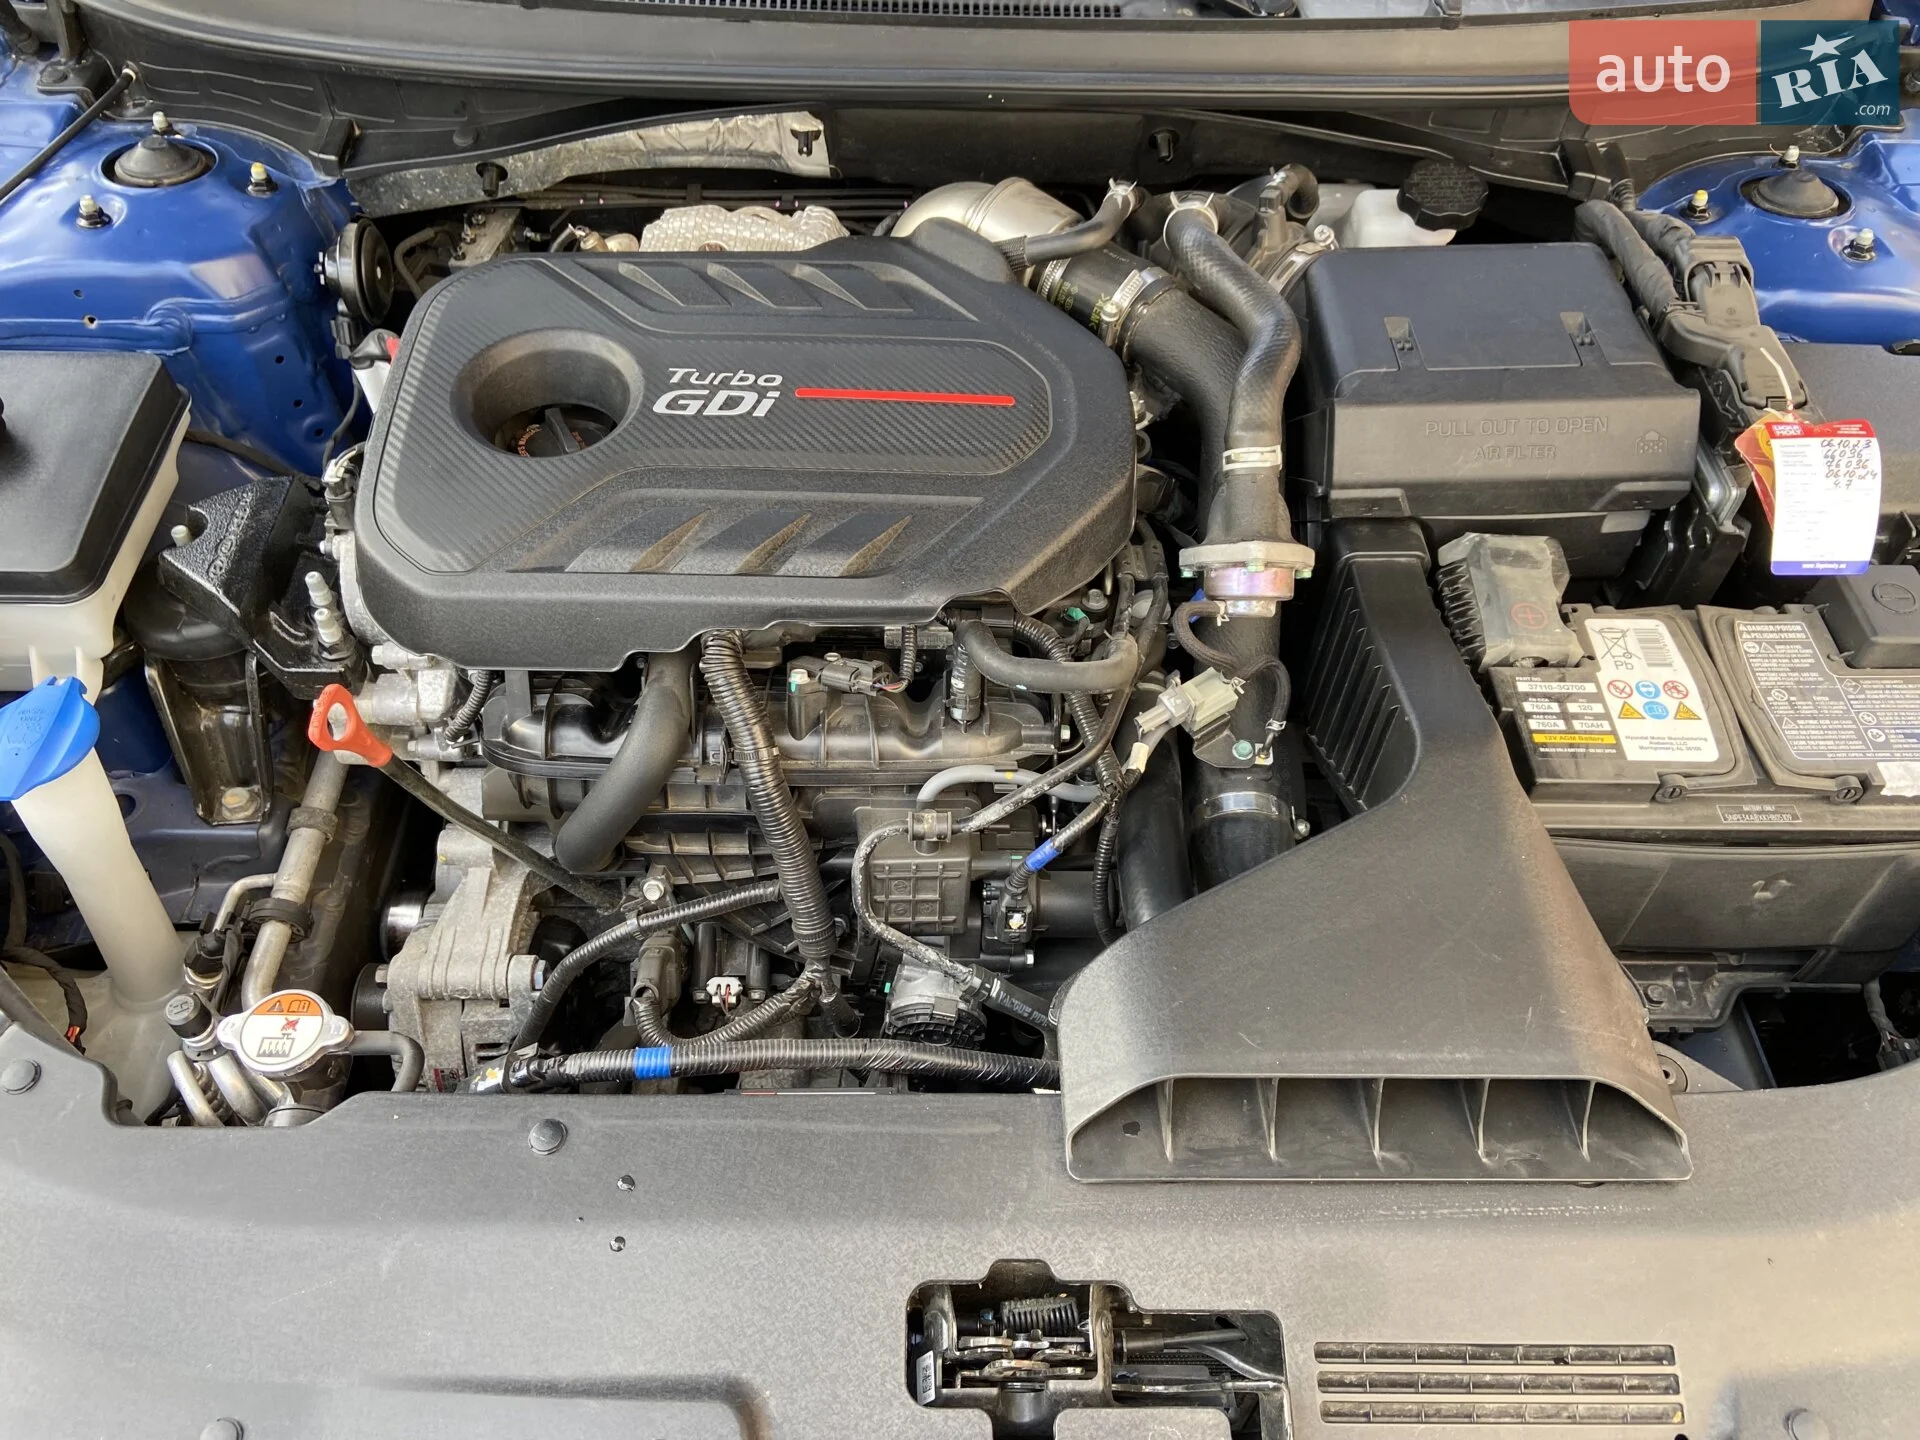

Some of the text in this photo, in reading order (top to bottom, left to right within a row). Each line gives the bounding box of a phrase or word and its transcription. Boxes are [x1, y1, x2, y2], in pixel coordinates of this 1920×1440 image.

[668, 368, 783, 386] Turbo
[652, 389, 781, 417] GDi
[1425, 416, 1609, 436] PULL OUT TO OPEN
[1474, 445, 1557, 460] AIR FILTER
[1614, 660, 1634, 671] Pb
[1530, 703, 1554, 711] 760A
